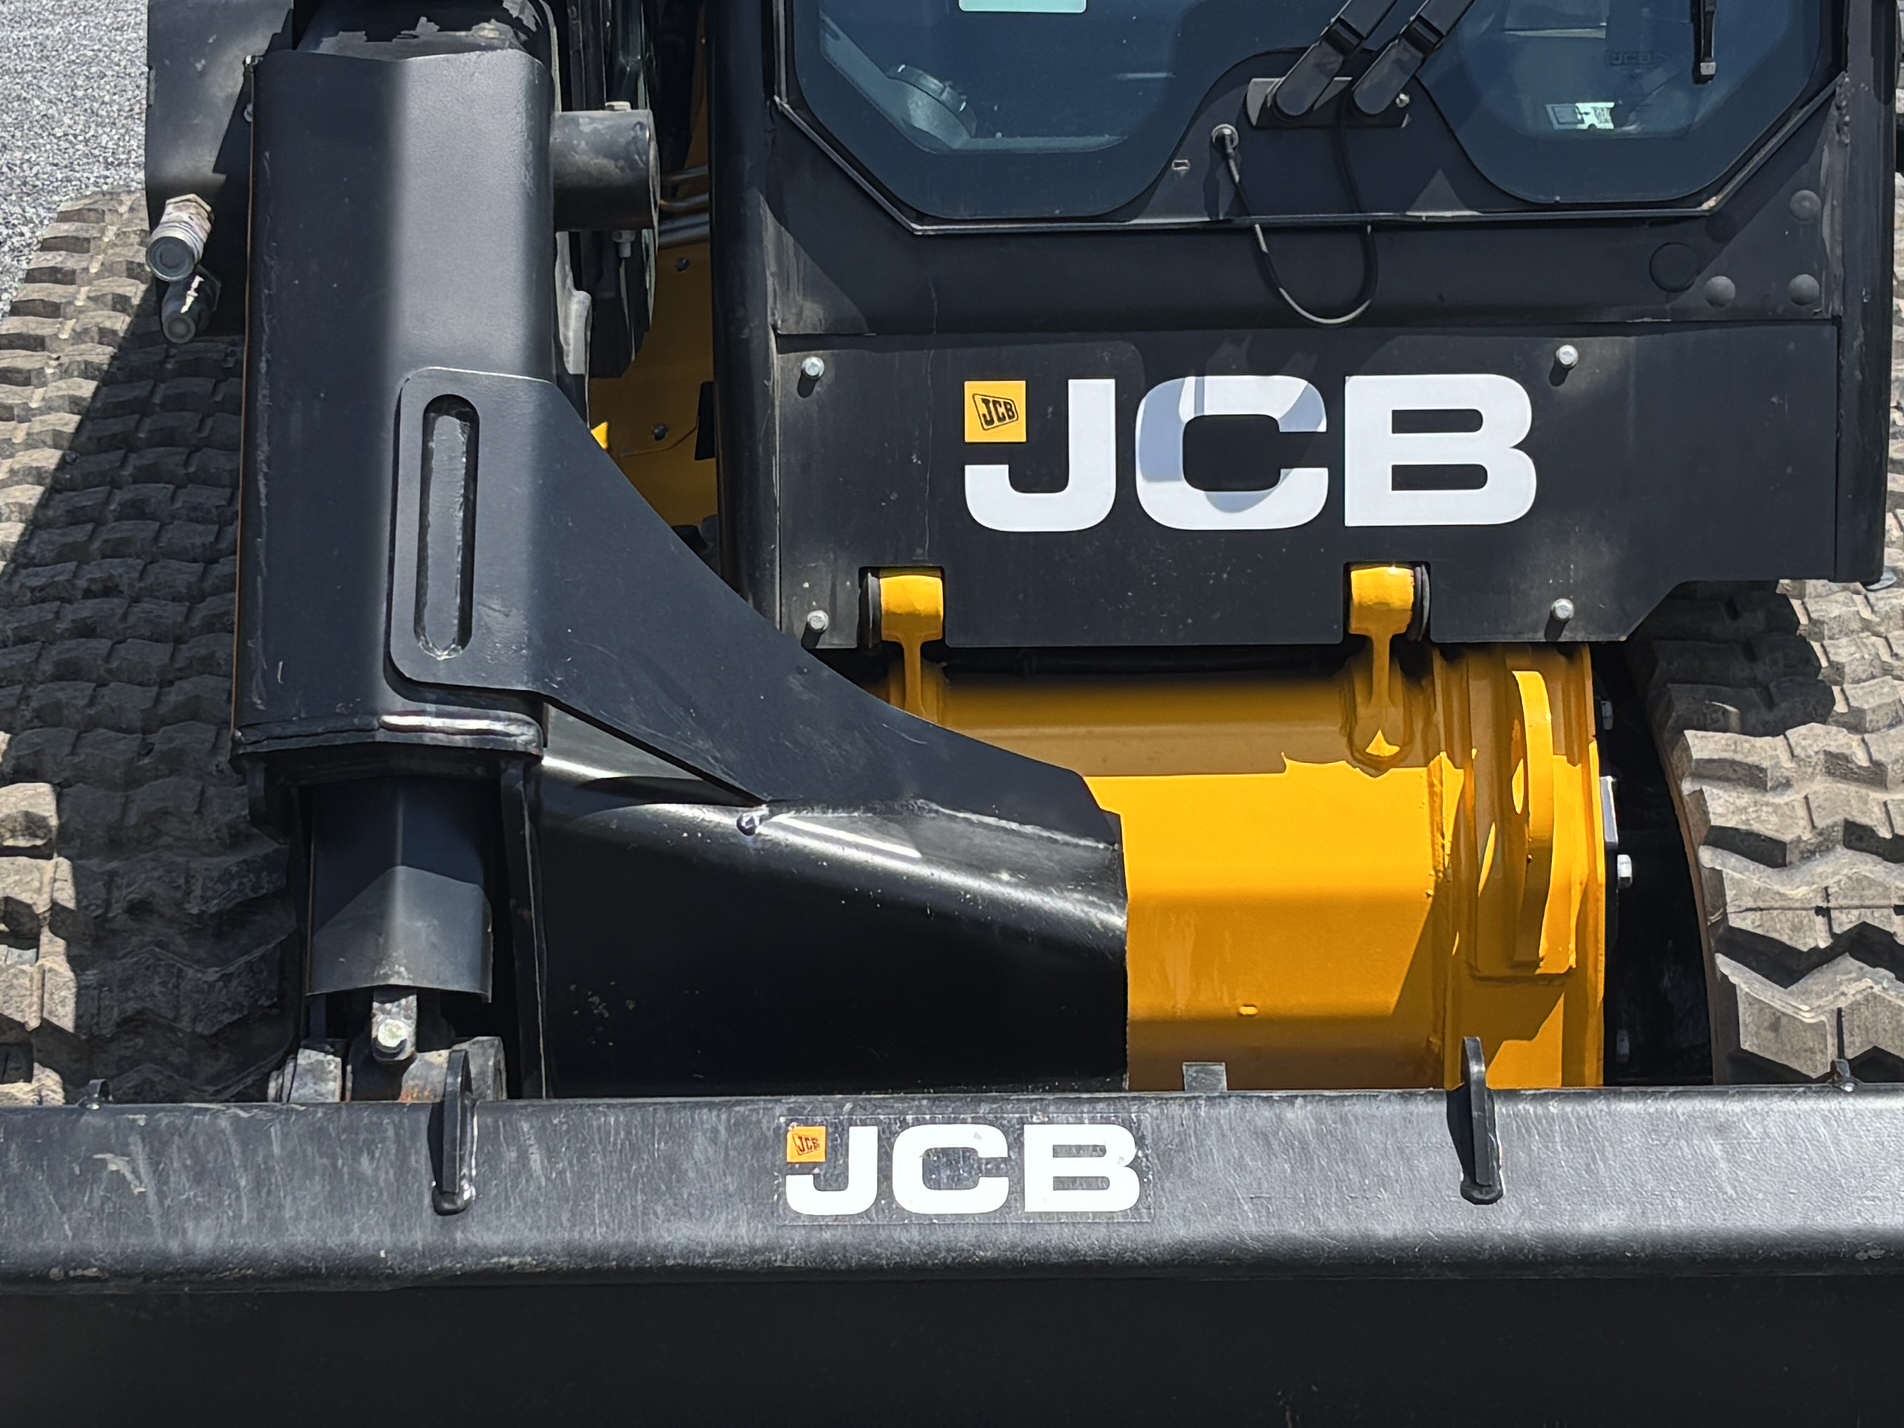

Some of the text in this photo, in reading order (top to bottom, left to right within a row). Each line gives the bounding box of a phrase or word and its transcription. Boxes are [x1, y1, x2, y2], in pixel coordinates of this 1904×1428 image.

[964, 373, 1538, 533] JCB
[981, 397, 1016, 427] JCB
[785, 1123, 1141, 1216] JCB
